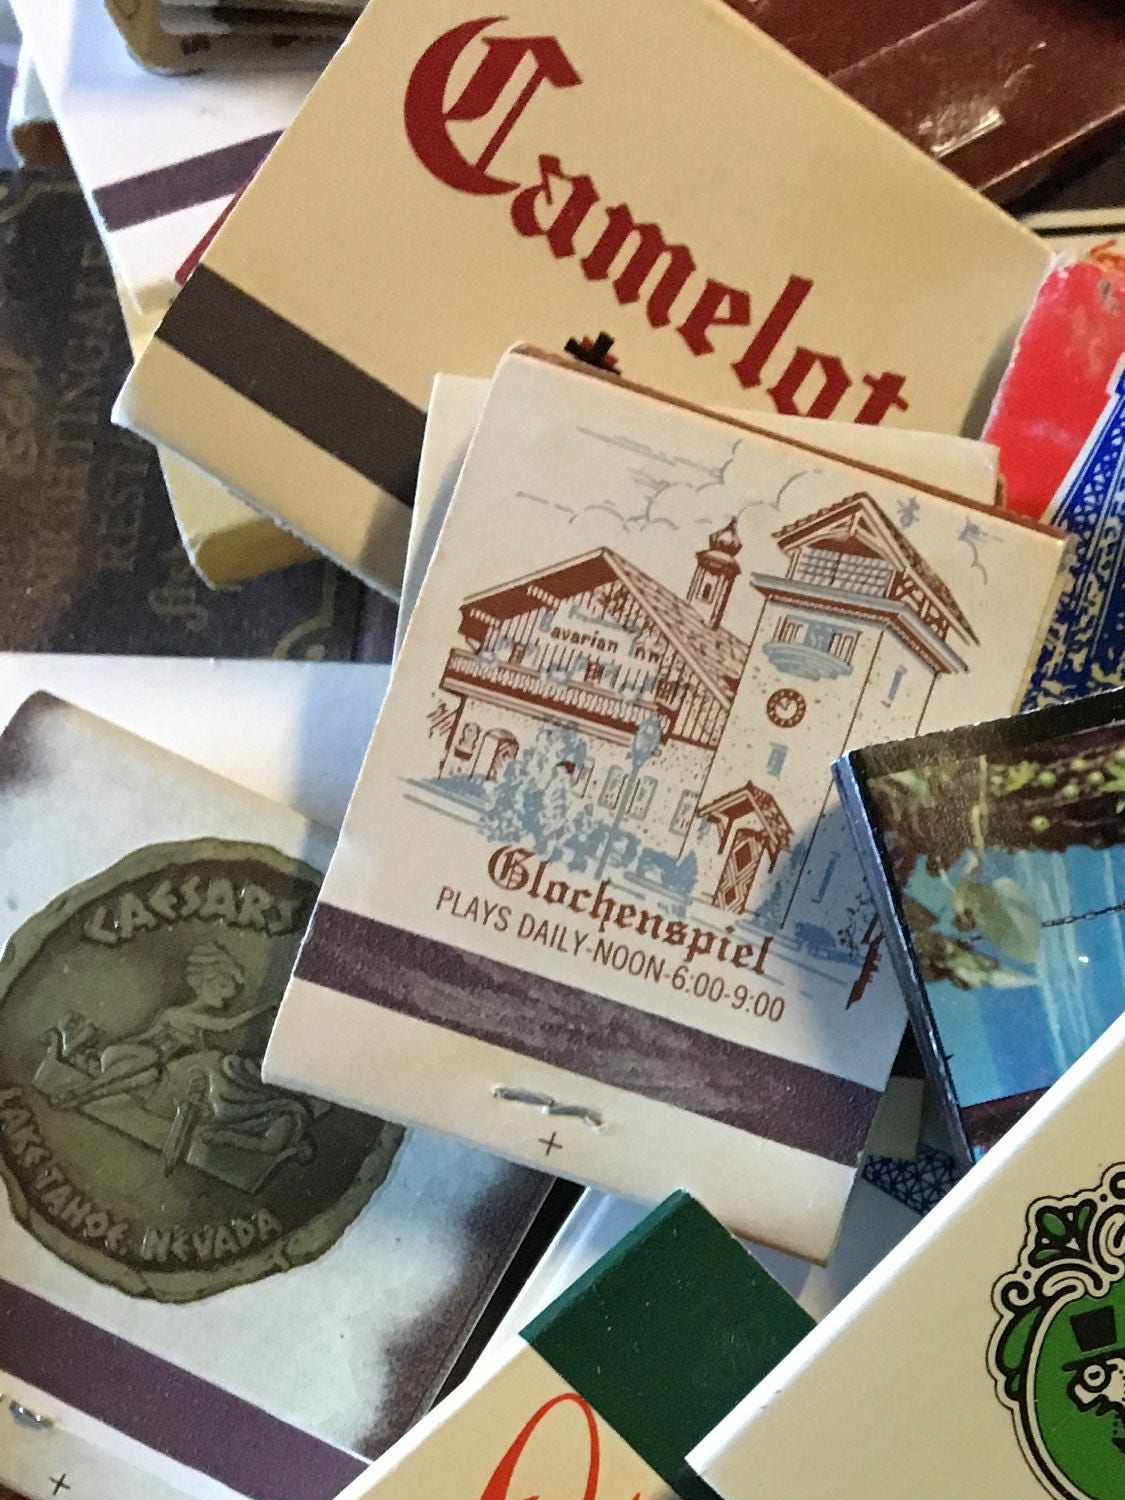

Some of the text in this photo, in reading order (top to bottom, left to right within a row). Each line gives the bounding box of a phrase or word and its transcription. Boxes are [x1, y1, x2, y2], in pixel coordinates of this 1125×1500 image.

[403, 15, 909, 426] Camelot
[434, 885, 786, 1023] PLAYS DAILY-NOON-6:00-9:00
[141, 1206, 284, 1264] NEVADA
